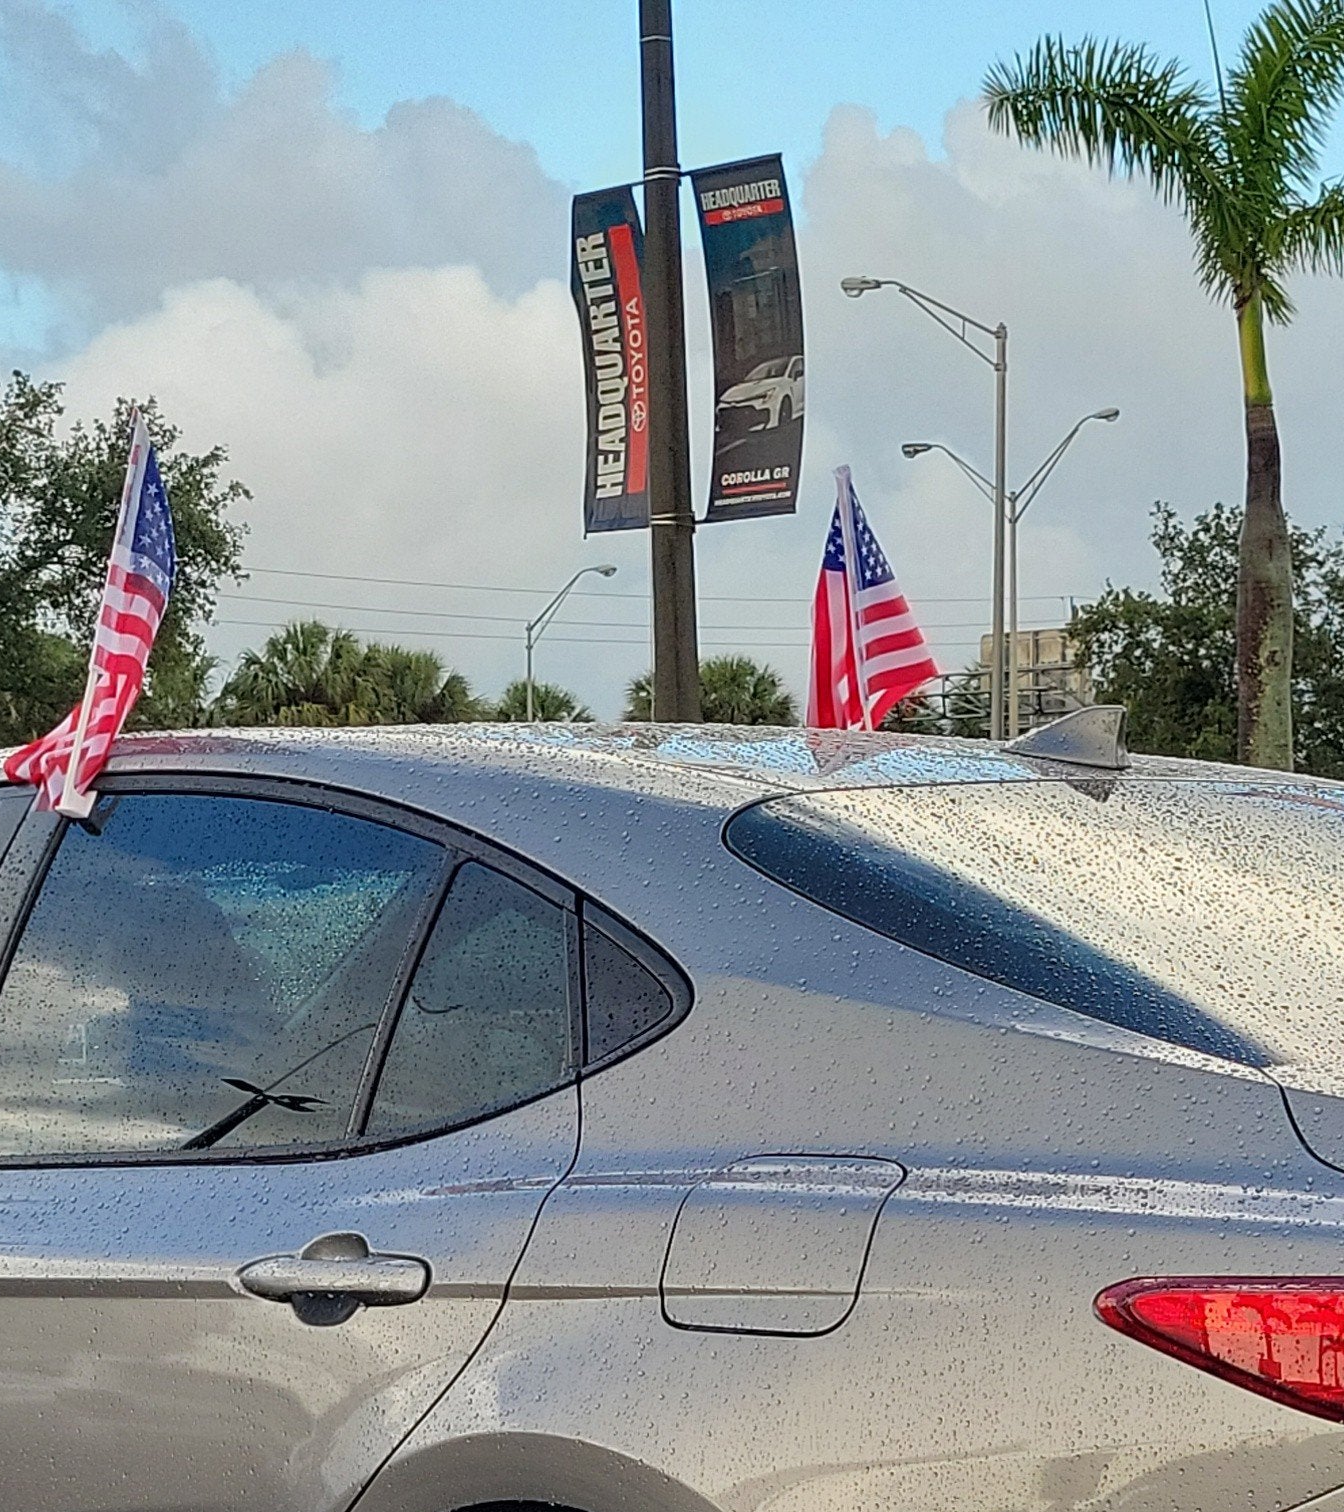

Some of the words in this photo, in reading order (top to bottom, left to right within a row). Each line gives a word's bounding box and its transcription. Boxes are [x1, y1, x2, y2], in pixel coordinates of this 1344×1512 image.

[700, 179, 781, 211] HEADQUARTER
[576, 231, 628, 500] HEADQUARTER
[626, 296, 645, 399] TOYOTA
[721, 468, 771, 486] COROLLA
[773, 466, 790, 479] GR
